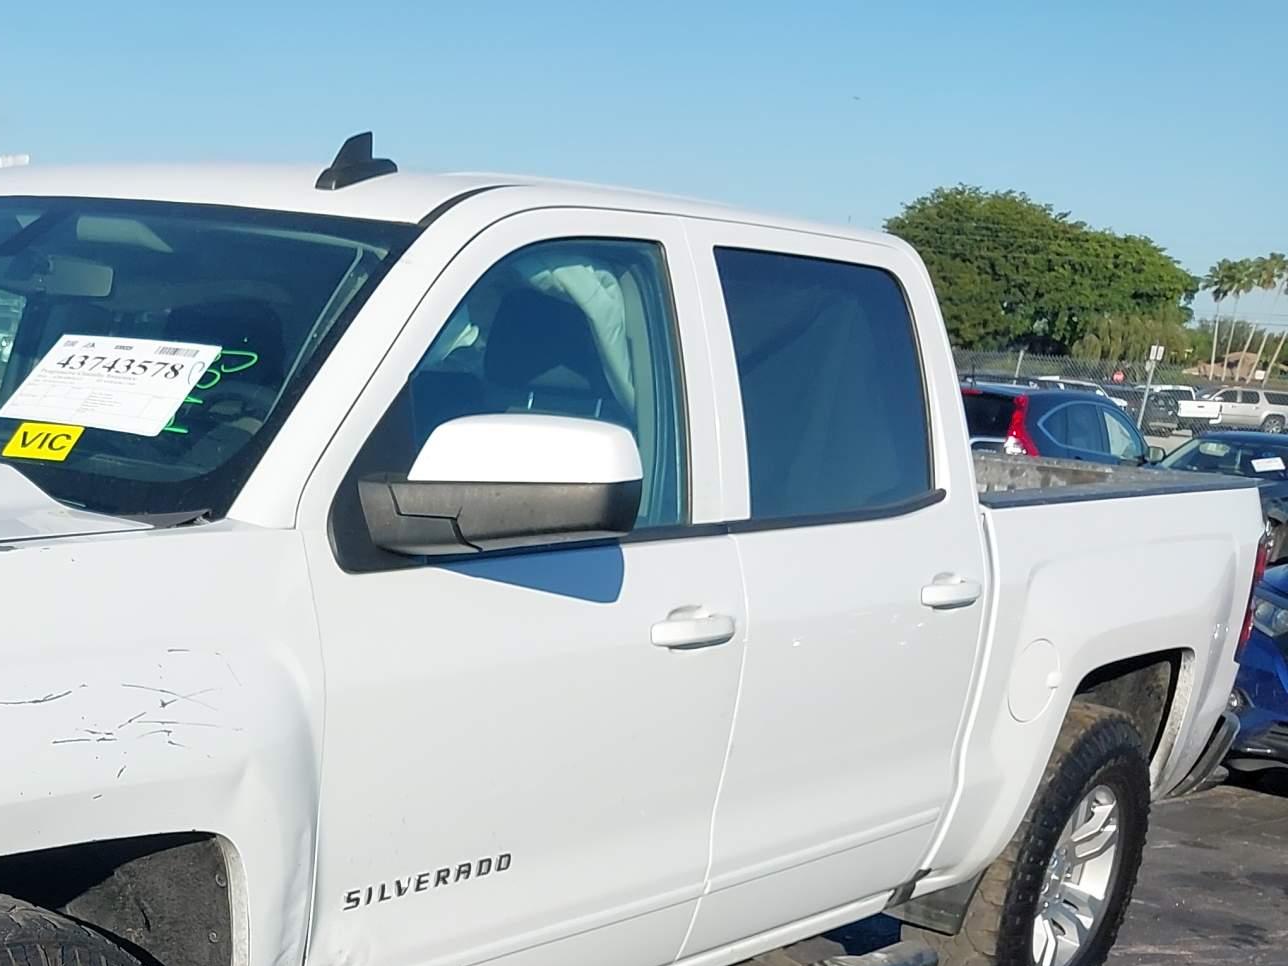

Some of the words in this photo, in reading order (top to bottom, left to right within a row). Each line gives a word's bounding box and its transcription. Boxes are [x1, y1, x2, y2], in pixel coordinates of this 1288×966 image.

[56, 353, 185, 380] 43743578
[20, 430, 73, 452] VIC
[342, 852, 513, 911] SILVERADO
